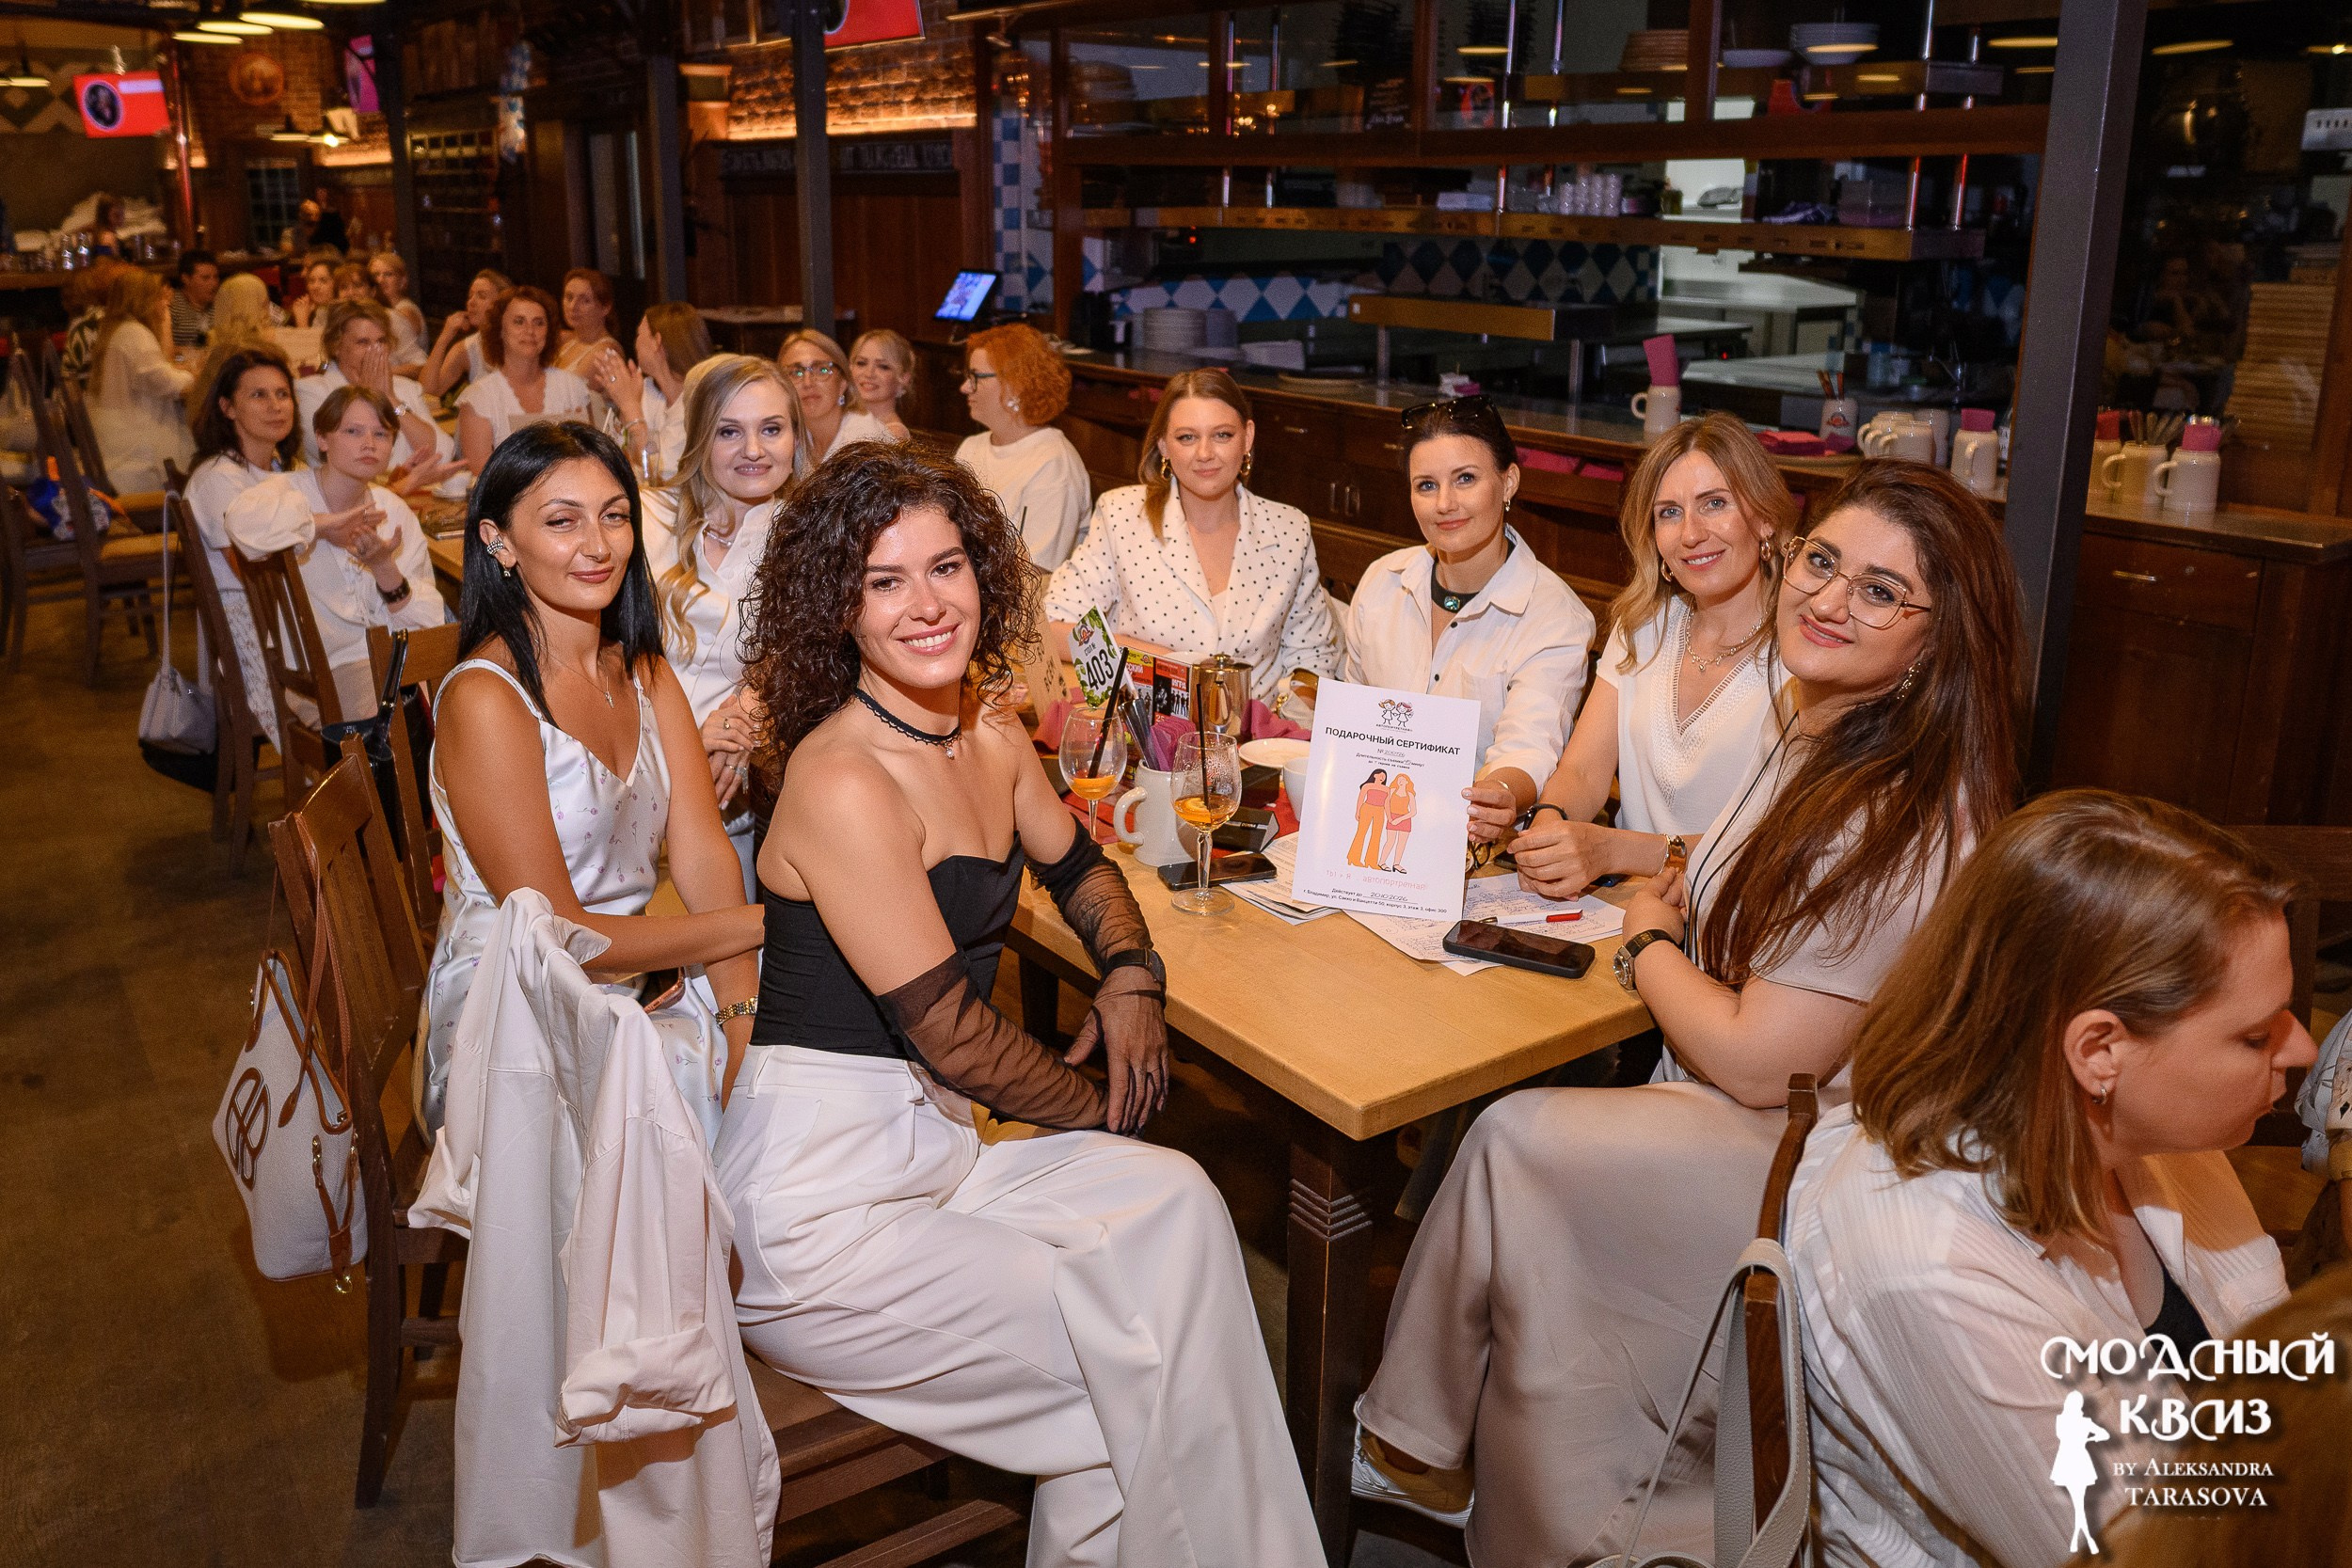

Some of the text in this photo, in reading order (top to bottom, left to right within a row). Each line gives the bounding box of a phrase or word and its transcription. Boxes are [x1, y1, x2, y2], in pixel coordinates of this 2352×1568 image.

[1086, 649, 1114, 690] 403
[1326, 727, 1460, 755] ПОДАРОЧНЫЙ СЕРТИФИКАТ
